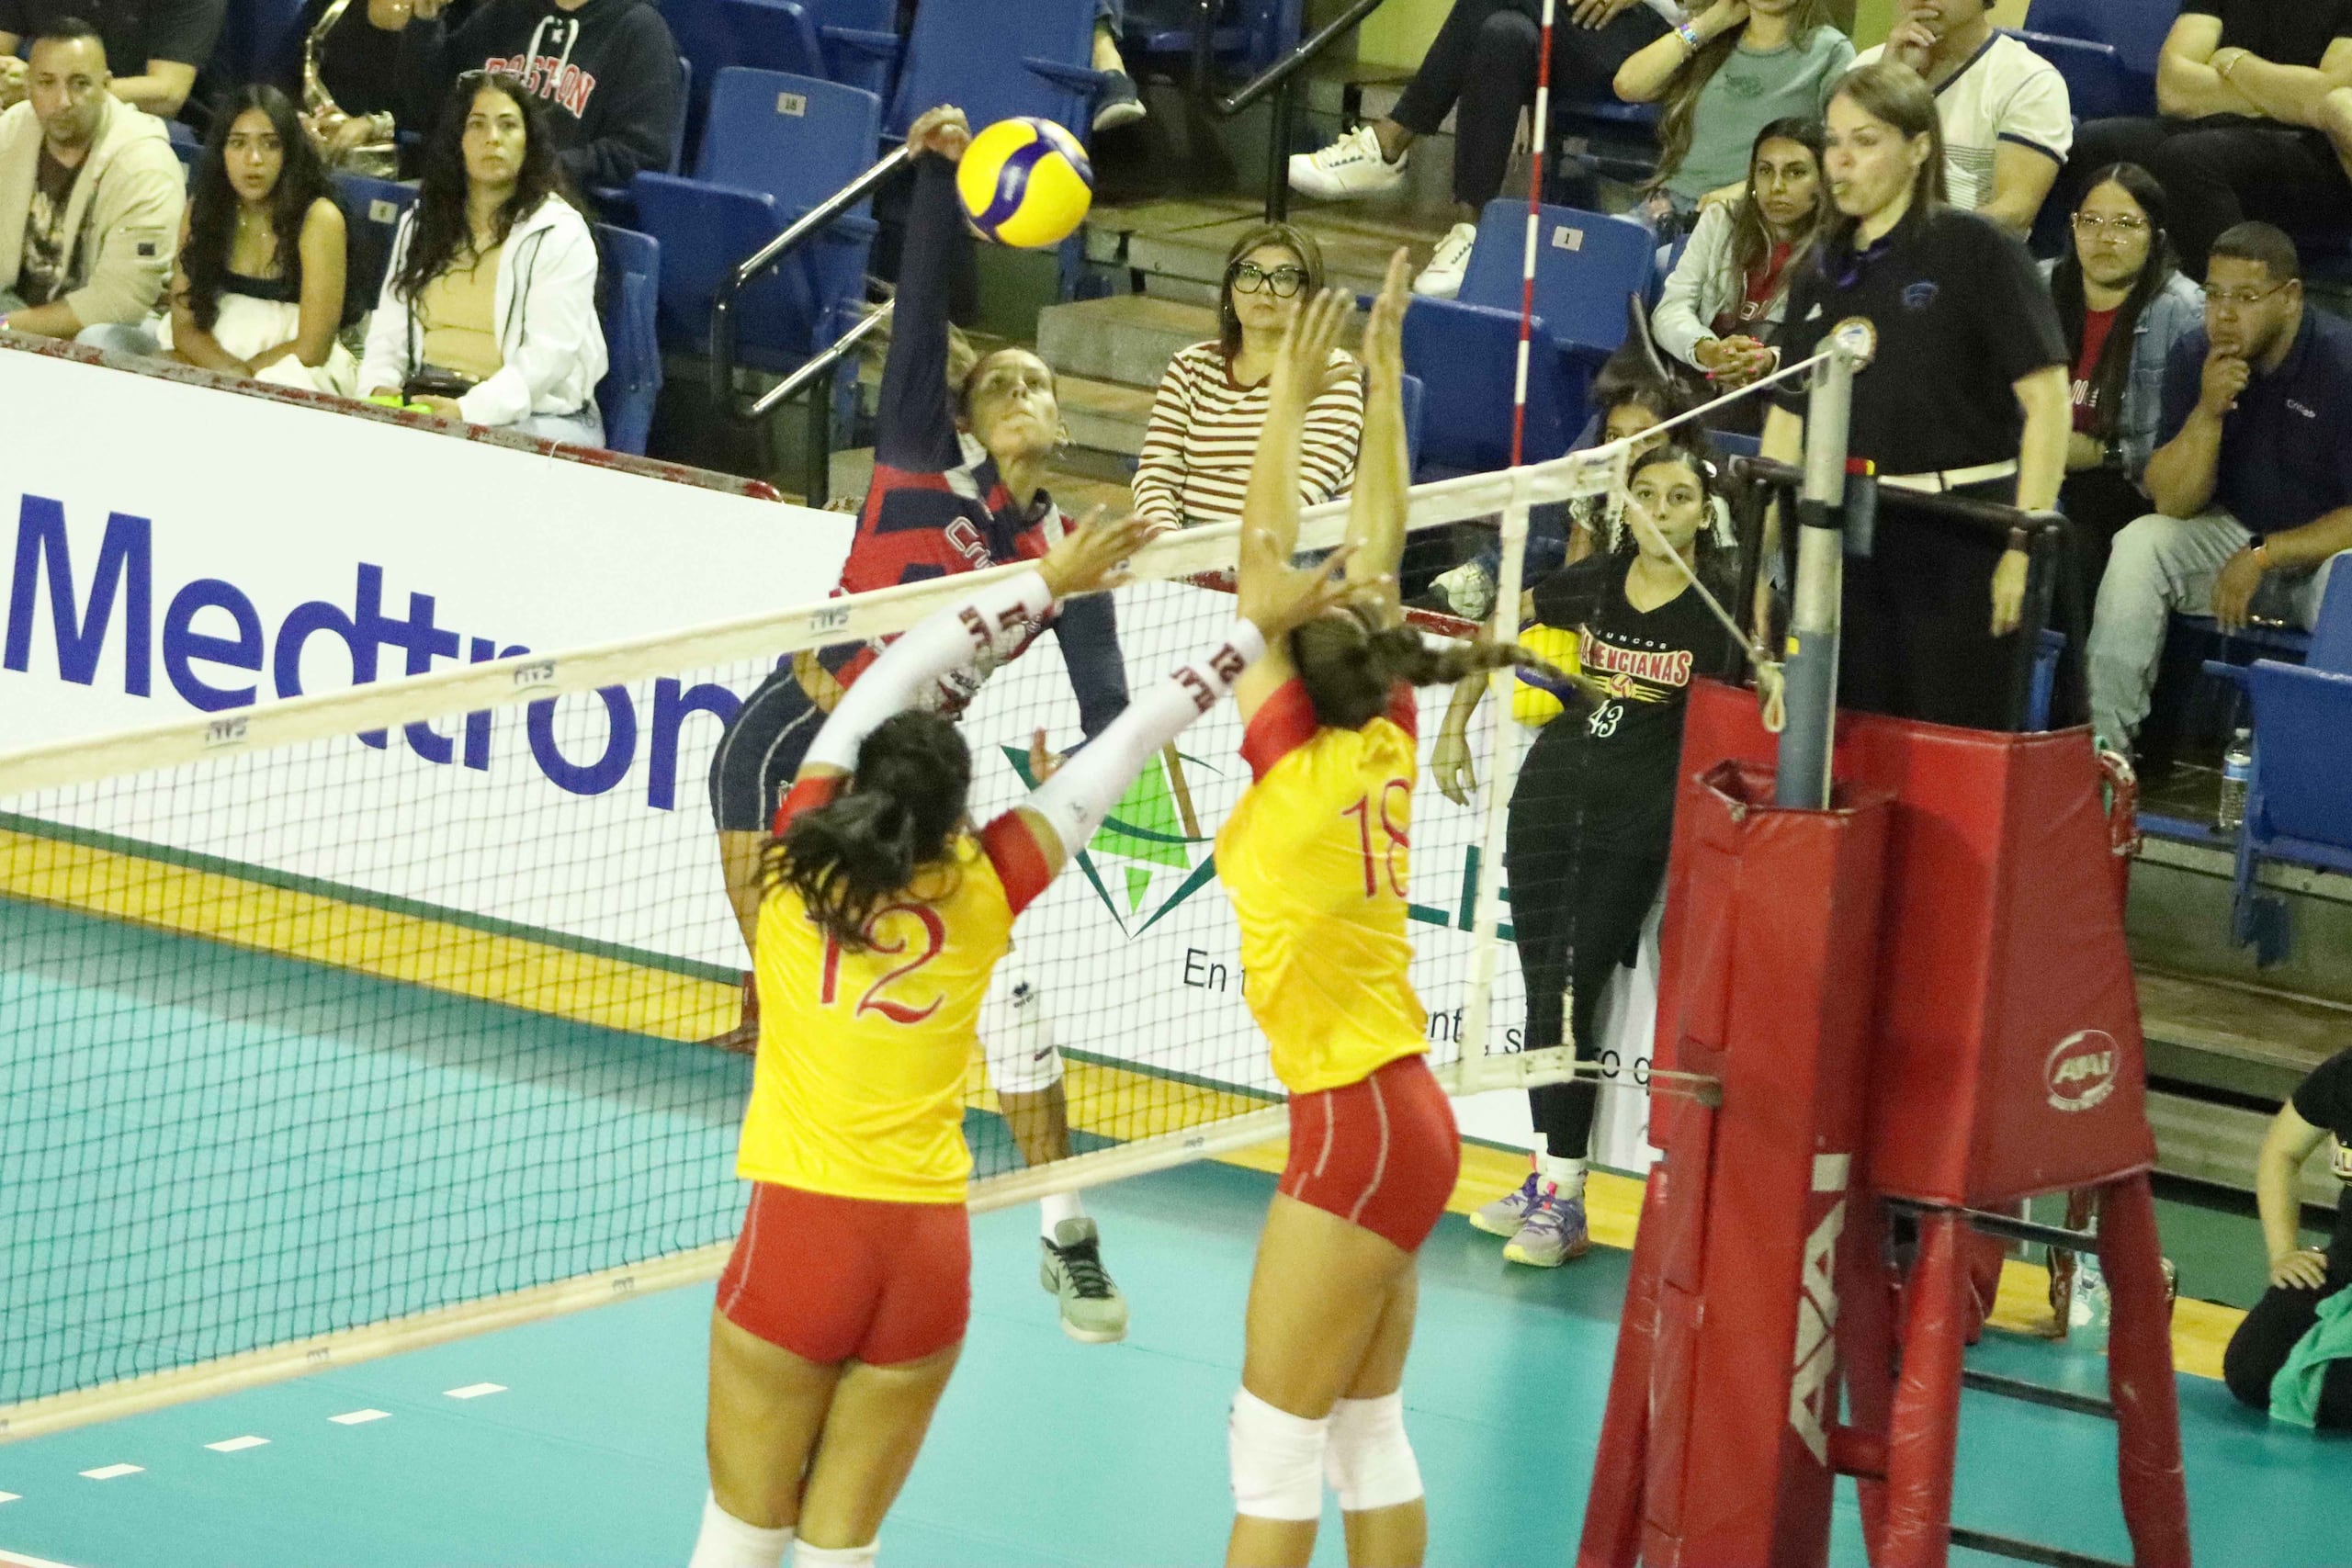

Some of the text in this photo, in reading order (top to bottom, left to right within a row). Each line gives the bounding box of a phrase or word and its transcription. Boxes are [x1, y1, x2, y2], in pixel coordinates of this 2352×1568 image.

[4, 493, 792, 810] Medtron
[1588, 699, 1624, 739] 43
[807, 902, 946, 1024] 12
[1183, 947, 1227, 993] En
